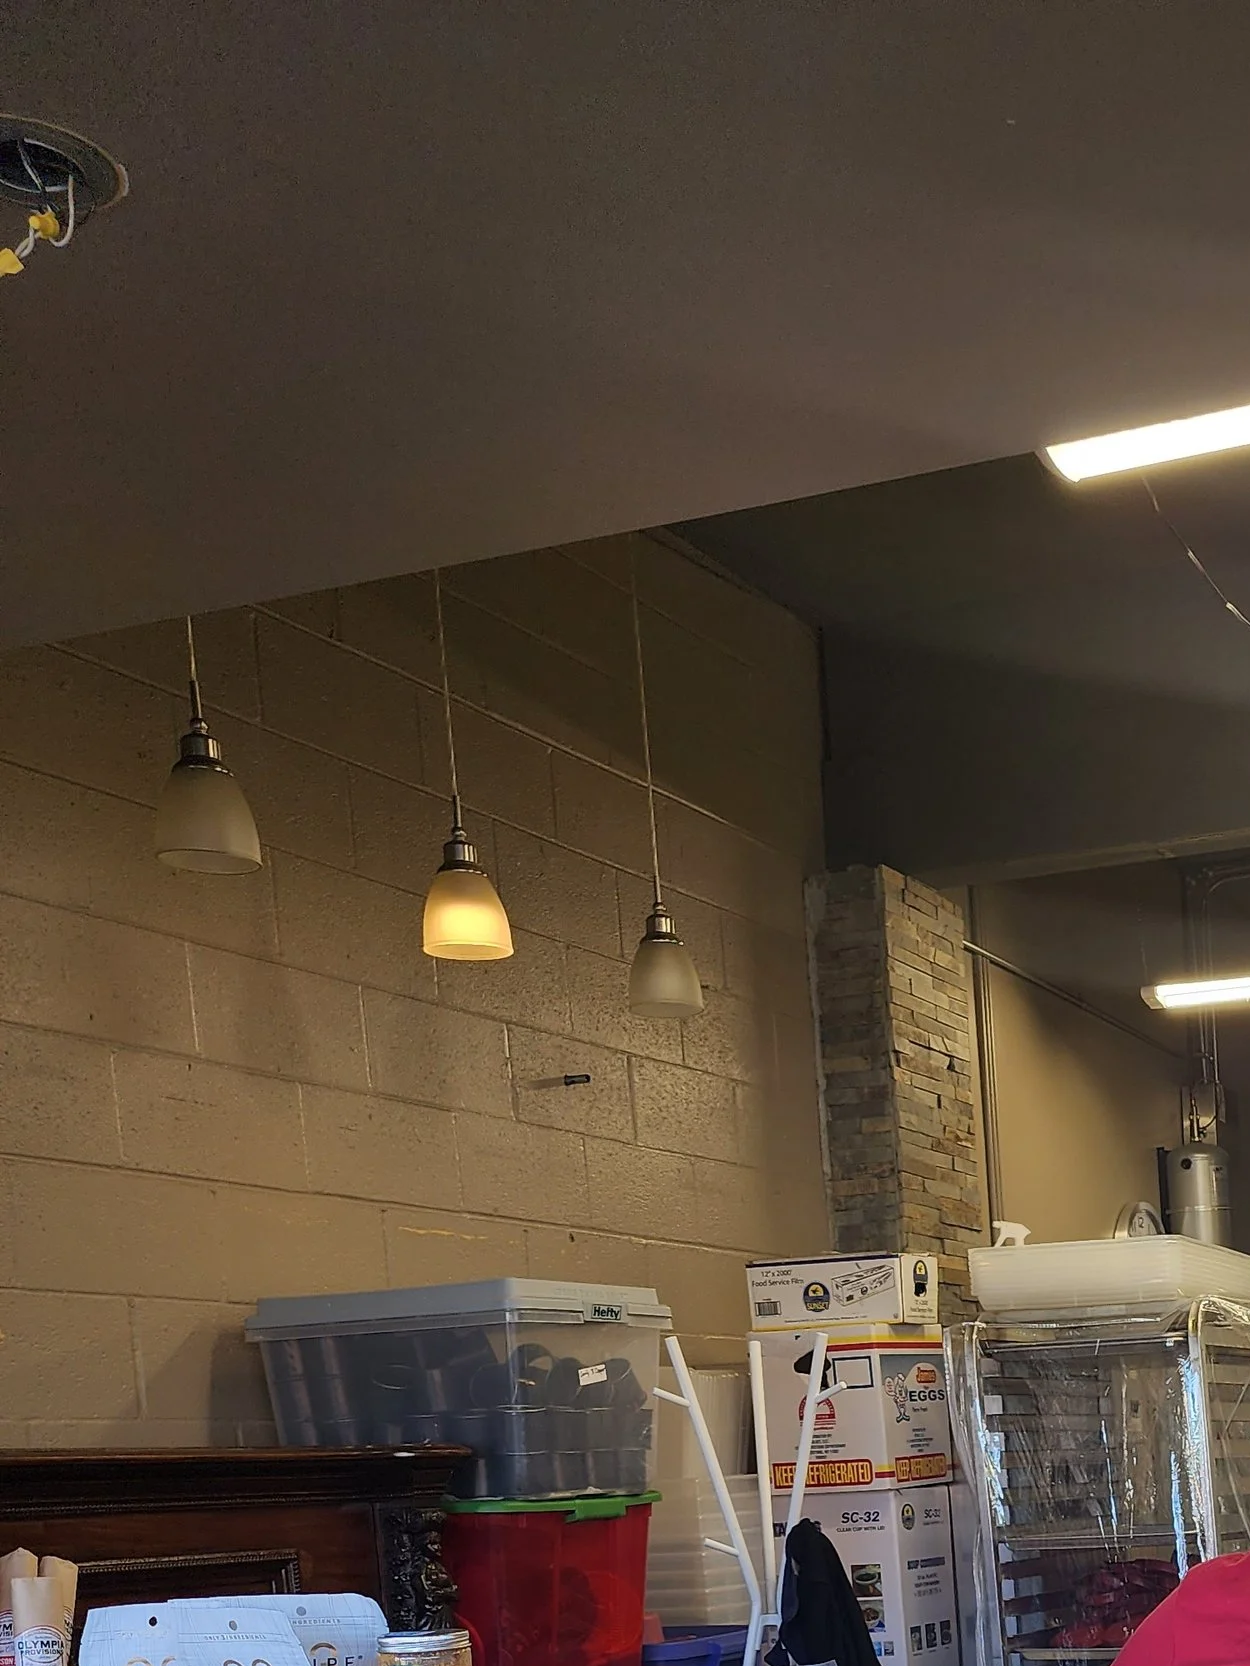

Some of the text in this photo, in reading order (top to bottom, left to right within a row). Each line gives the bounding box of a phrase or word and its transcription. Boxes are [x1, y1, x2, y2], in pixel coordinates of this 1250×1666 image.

[768, 1279, 790, 1287] Service
[791, 1278, 804, 1286] Film
[593, 1306, 620, 1320] Hefty
[806, 1302, 830, 1312] SUNSET
[909, 1389, 946, 1402] EGGS
[775, 1464, 797, 1487] KEE
[841, 1511, 880, 1524] SC-32
